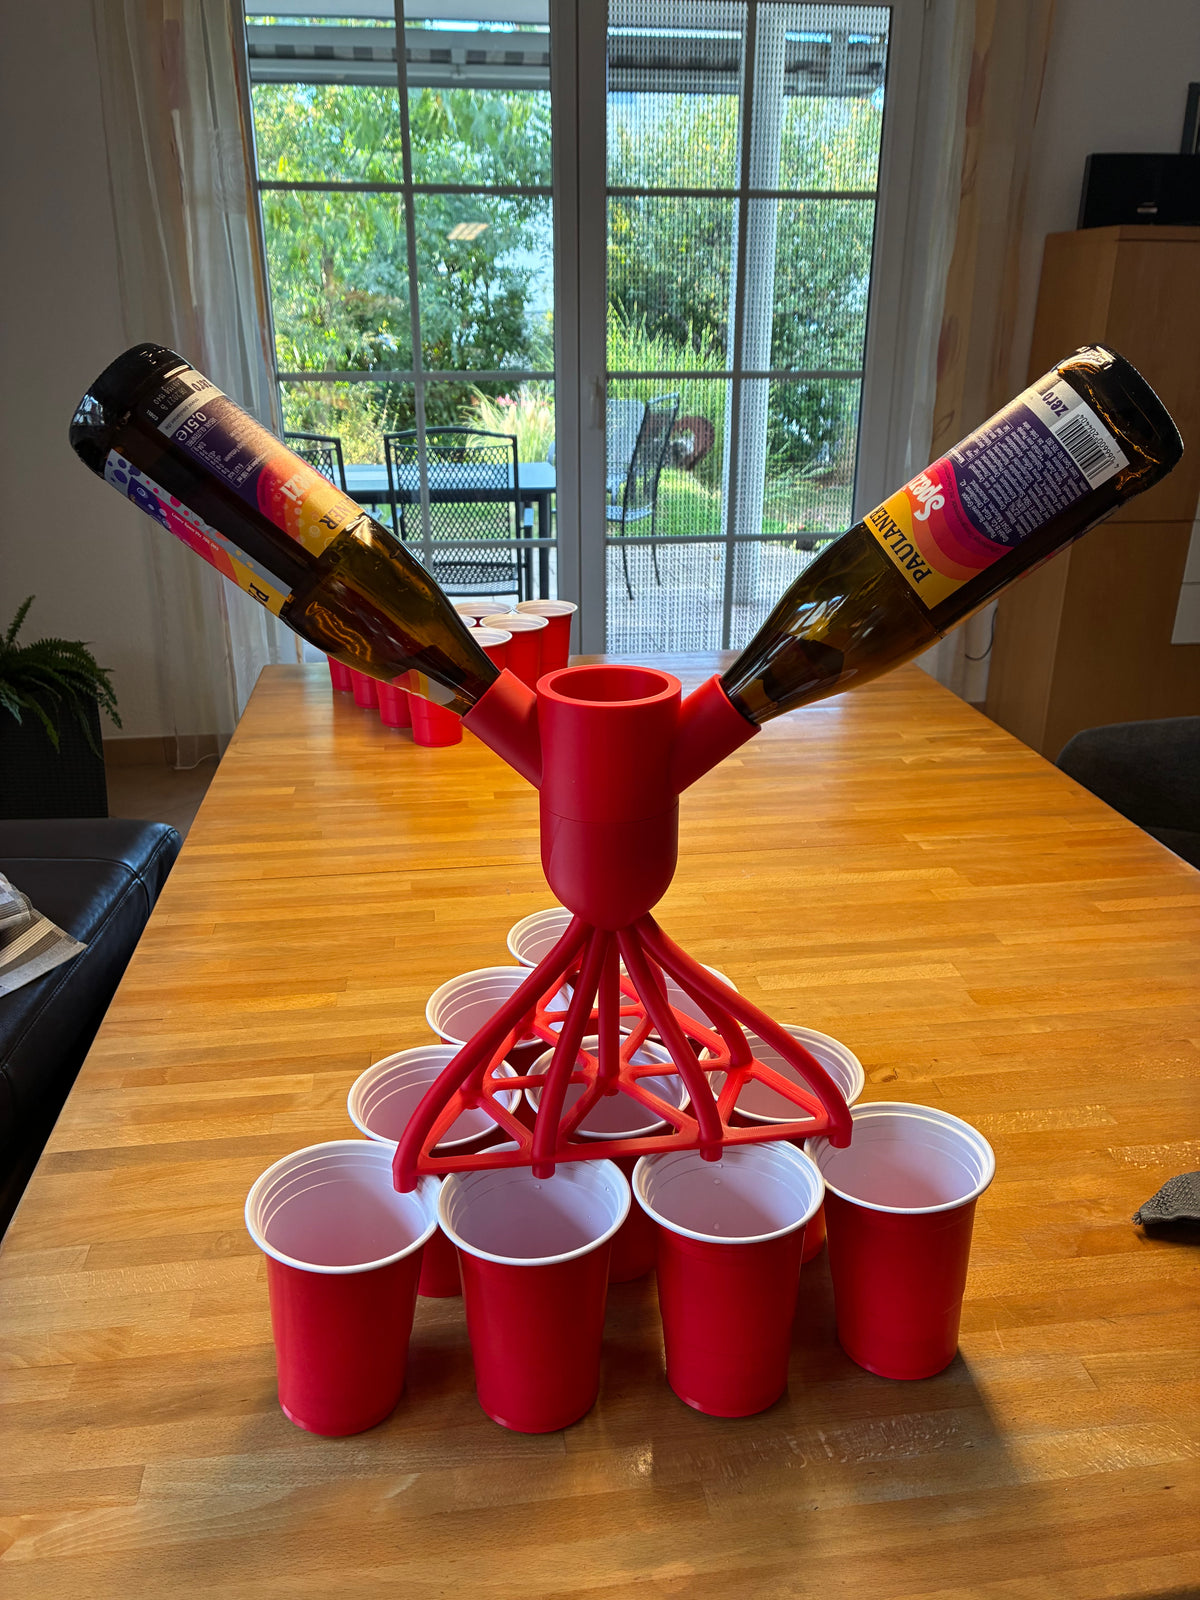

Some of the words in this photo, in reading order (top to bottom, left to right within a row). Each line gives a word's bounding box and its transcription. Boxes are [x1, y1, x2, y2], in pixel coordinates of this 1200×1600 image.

[1042, 390, 1068, 417] zero
[902, 472, 946, 522] Spezi
[868, 505, 932, 583] PAULANER
